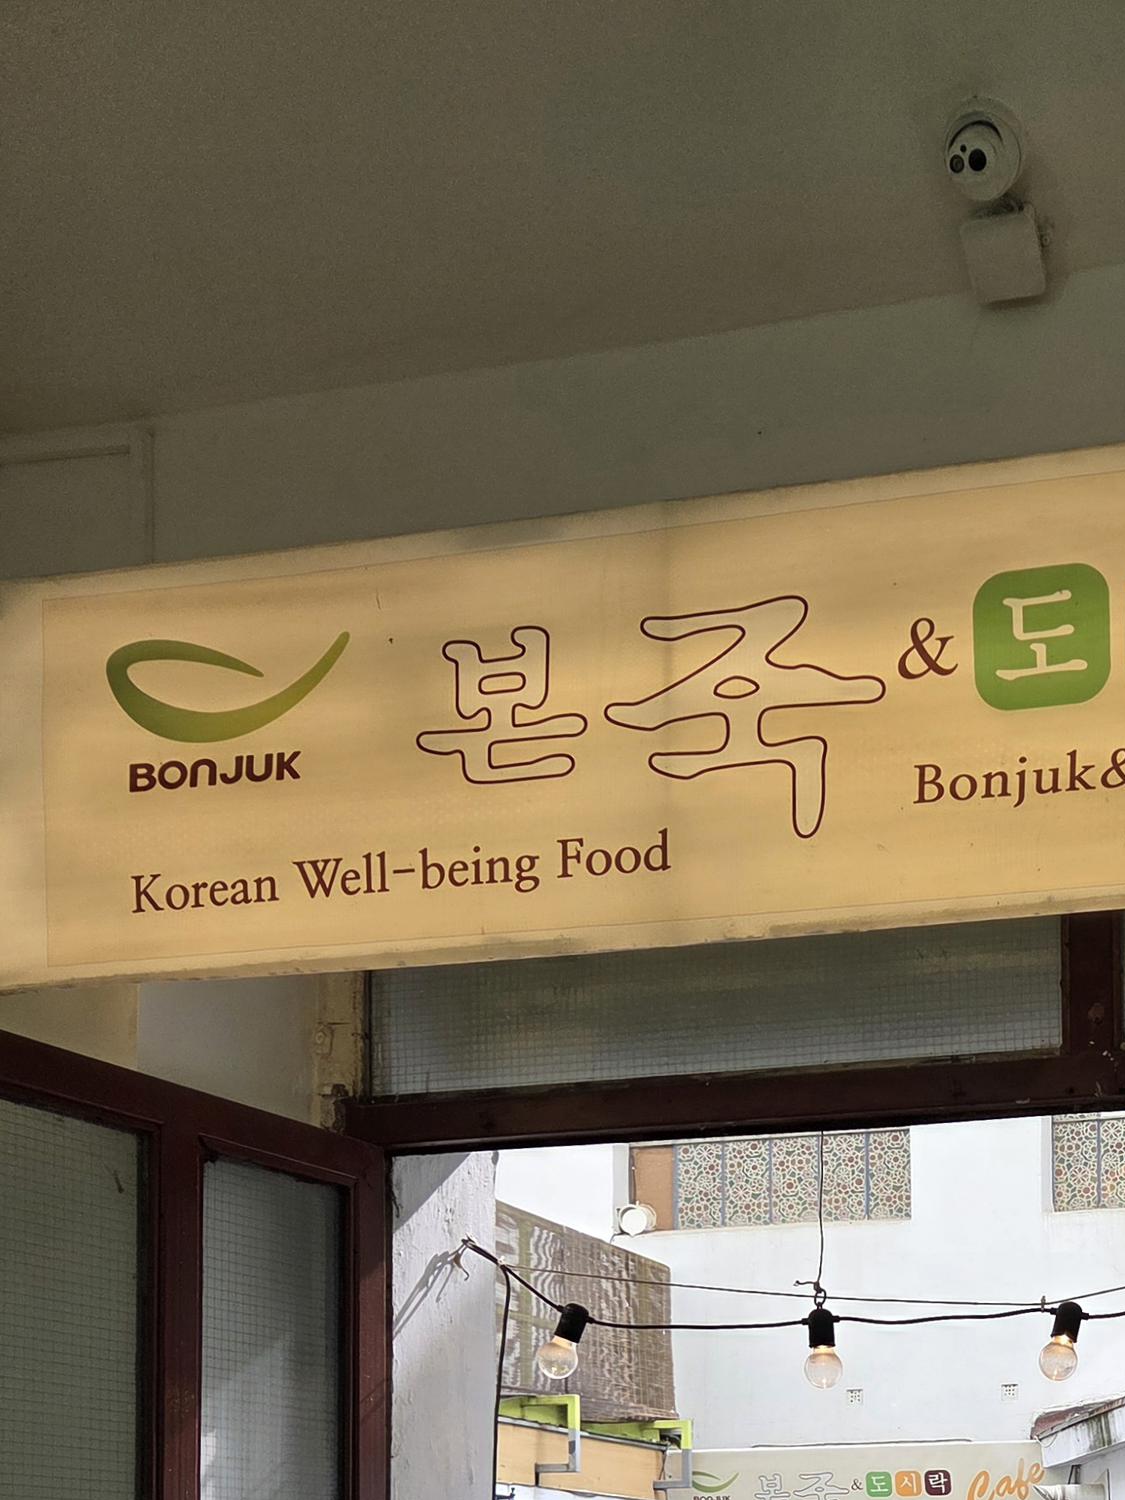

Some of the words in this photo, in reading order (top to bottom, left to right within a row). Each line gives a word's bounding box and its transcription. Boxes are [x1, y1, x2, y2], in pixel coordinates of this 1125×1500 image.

[416, 595, 886, 838] 본죽
[897, 617, 959, 680] &
[129, 751, 301, 793] BONJUK
[131, 873, 280, 913] Korean
[292, 845, 540, 899] Well-being
[556, 827, 671, 878] Food
[851, 1479, 863, 1490] &
[869, 1471, 948, 1494] 도시락
